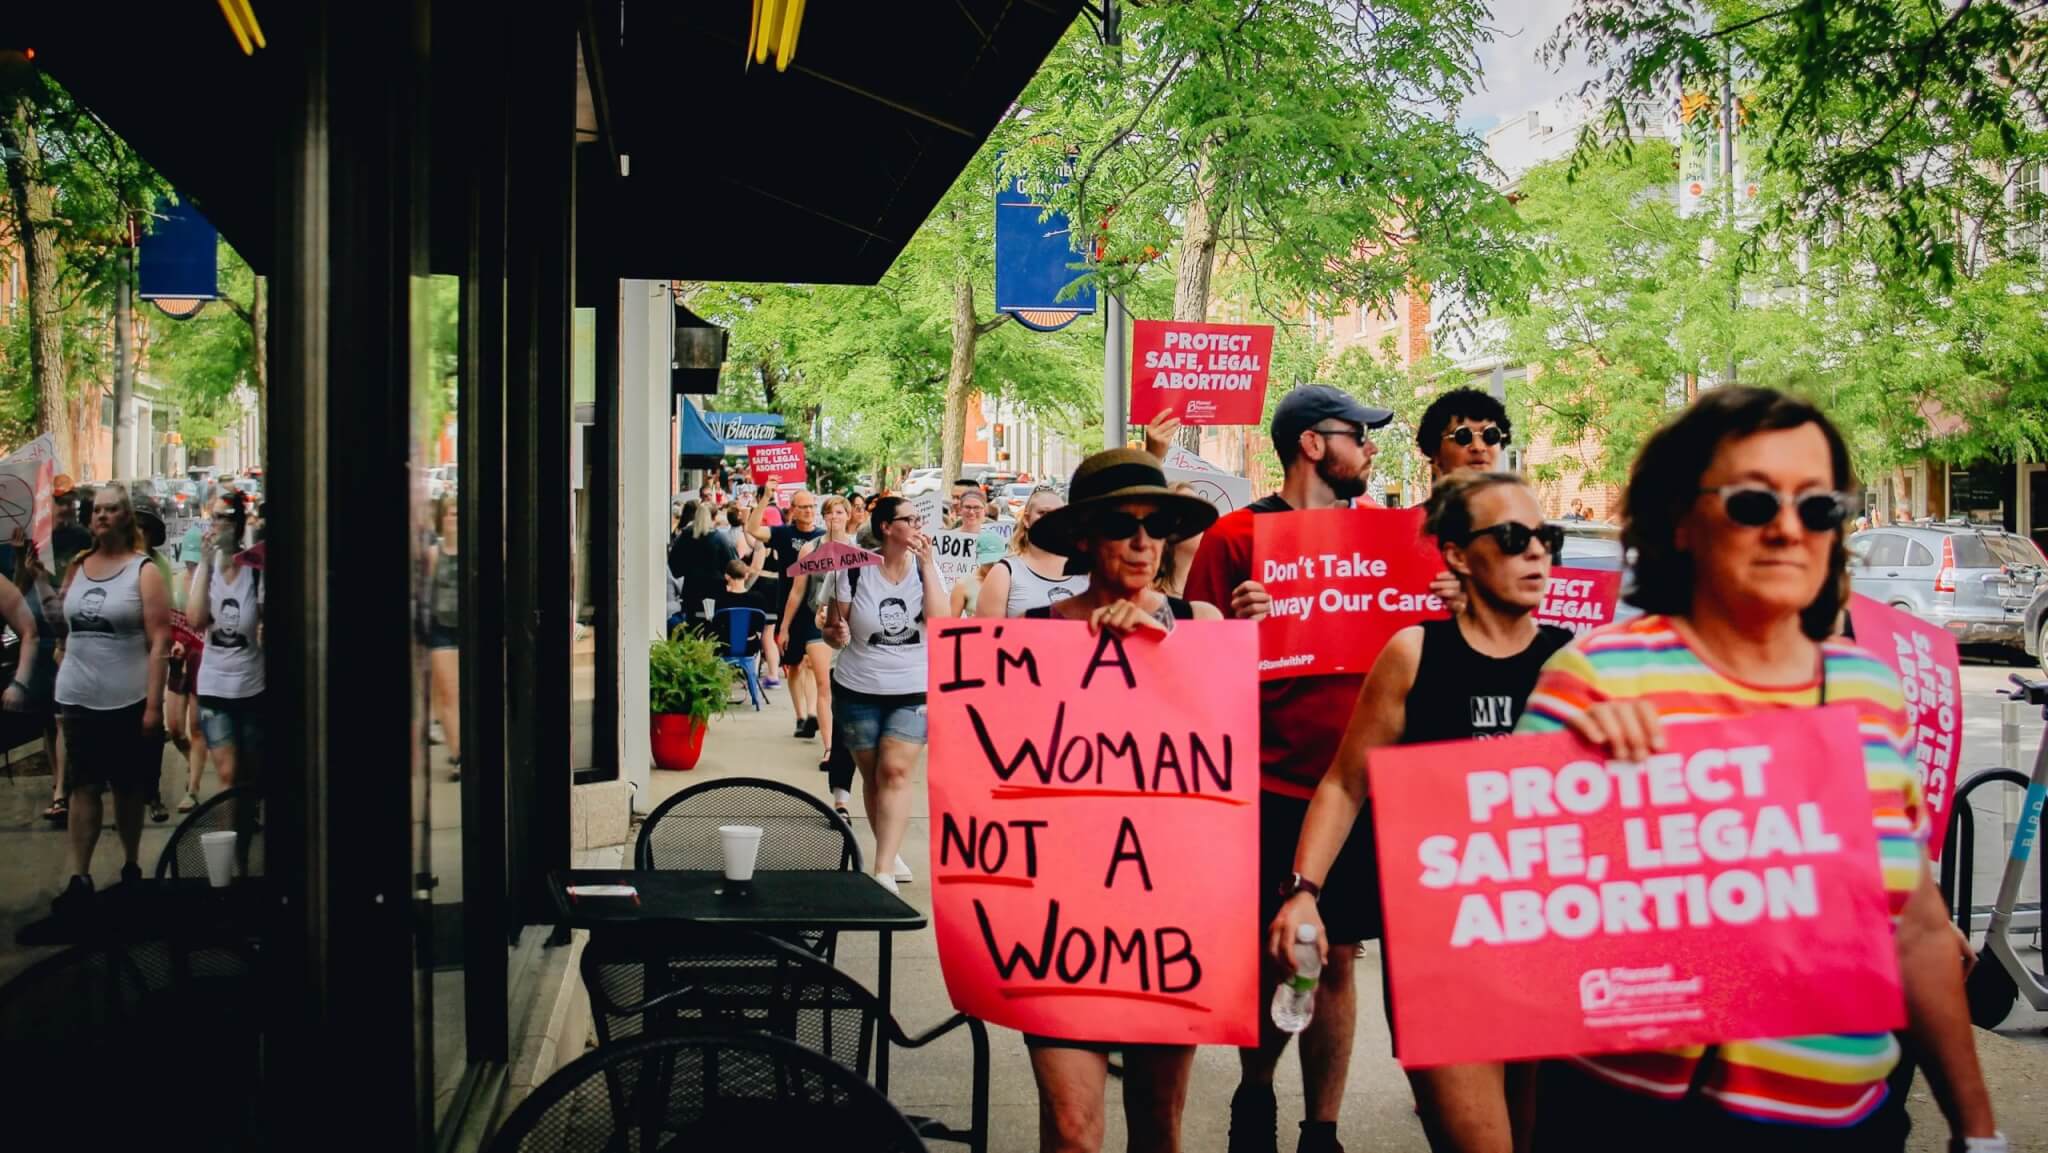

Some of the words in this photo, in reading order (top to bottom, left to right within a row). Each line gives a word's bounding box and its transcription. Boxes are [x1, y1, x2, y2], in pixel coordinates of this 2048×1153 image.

[1164, 332, 1252, 352] PROTECT
[1144, 351, 1203, 372] SAFE,
[1208, 354, 1261, 371] LEGAL
[1152, 371, 1253, 391] ABORTION
[725, 415, 777, 440] Bluestem
[755, 447, 792, 456] PROTECT
[773, 455, 800, 463] LEGAL
[756, 462, 797, 472] ABORTION
[931, 535, 977, 558] ABOR
[800, 557, 834, 572] NEVER
[840, 551, 869, 567] AGAIN
[1263, 555, 1315, 584] Don't
[1319, 552, 1388, 578] Take
[1319, 588, 1374, 613] Our
[1544, 577, 1595, 598] TECT
[1538, 598, 1604, 620] LEGAL
[1080, 629, 1137, 689] A
[1912, 630, 1937, 716] SAFE,
[1471, 695, 1512, 727] MY
[965, 701, 1232, 794] WOMAN
[1927, 663, 1954, 813] PROTECT
[1467, 744, 1771, 823] PROTECT
[2021, 801, 2042, 847] BIRD
[940, 812, 1048, 878] NOT
[1104, 816, 1153, 891] A
[1418, 824, 1608, 889] SAFE,
[1624, 802, 1840, 871] LEGAL
[1449, 864, 1819, 948] ABORTION
[973, 899, 1202, 994] WOMB
